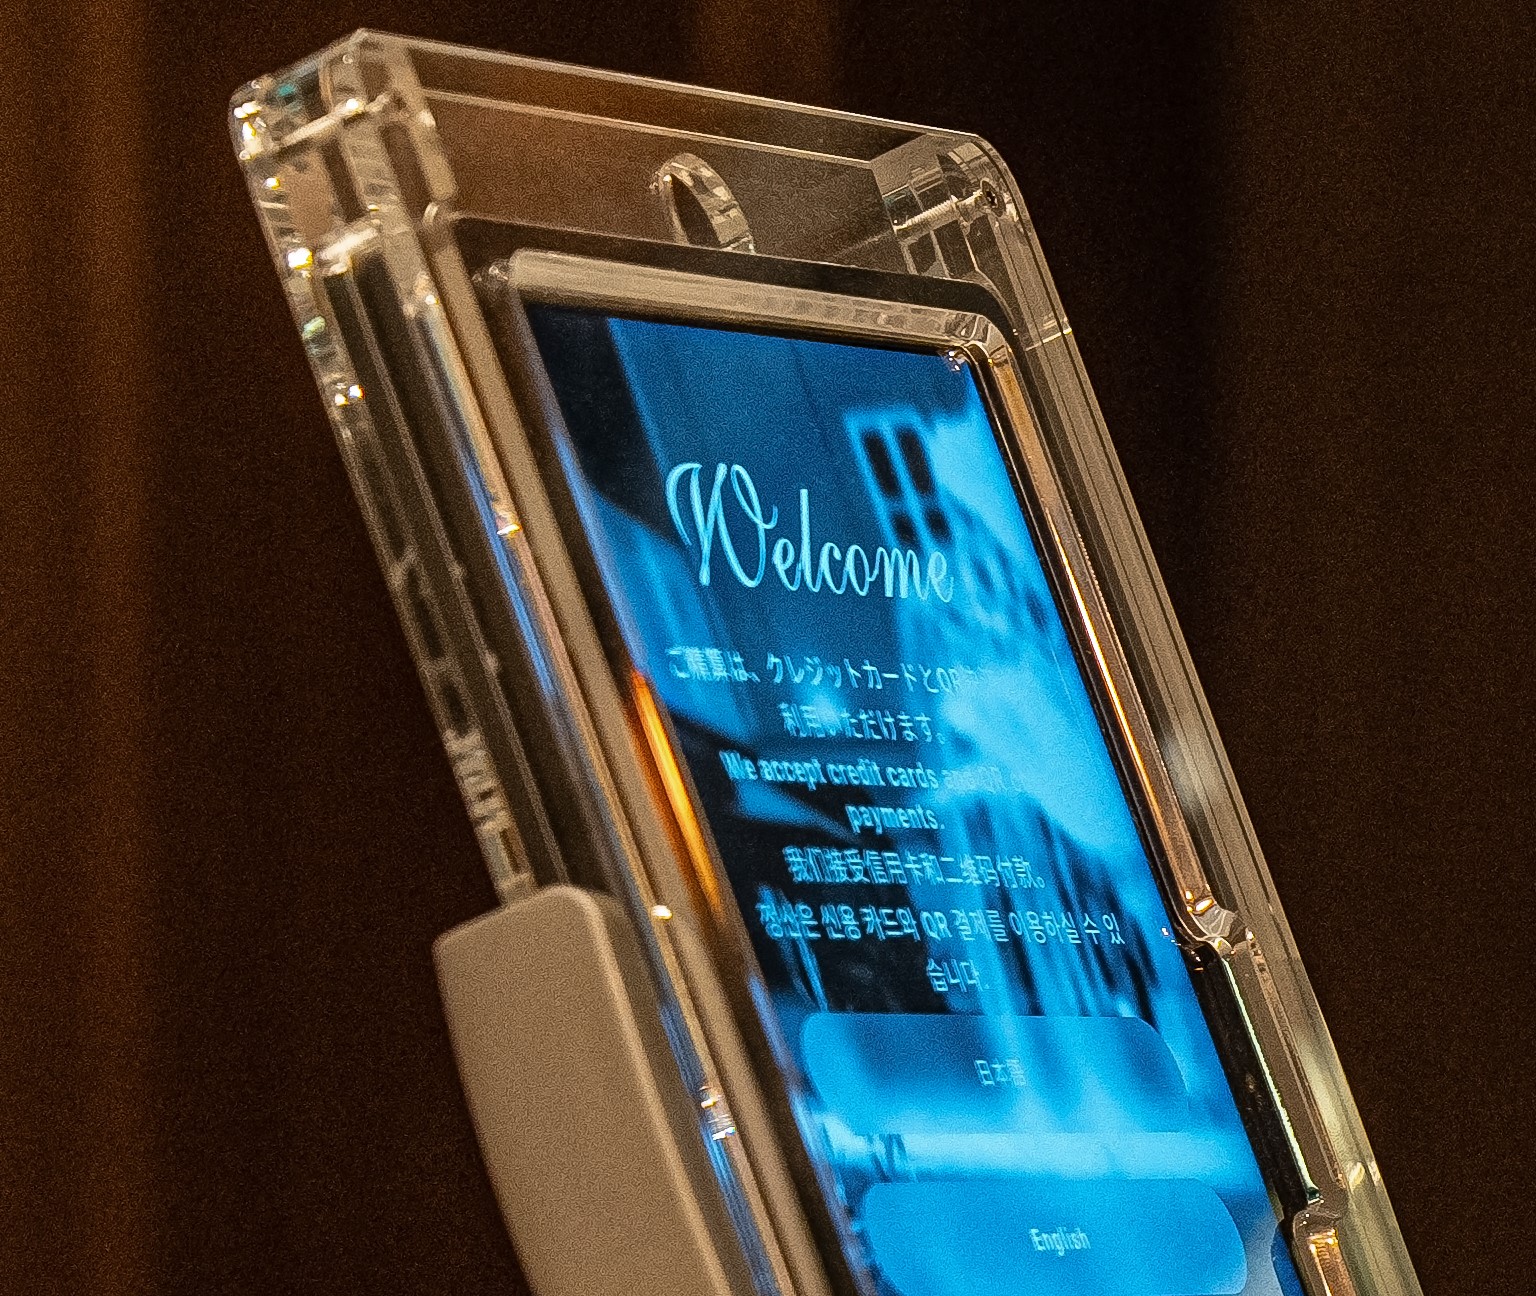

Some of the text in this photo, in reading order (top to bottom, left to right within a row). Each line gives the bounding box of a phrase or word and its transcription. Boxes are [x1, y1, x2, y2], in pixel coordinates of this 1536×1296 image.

[666, 462, 954, 603] Welcome
[719, 750, 759, 781] We
[757, 757, 828, 791] accept
[826, 757, 886, 787] credit
[885, 761, 939, 789] cards
[845, 804, 945, 835] payments.
[820, 904, 861, 942] 신용
[859, 904, 921, 943] 카드와
[920, 911, 953, 942] QR
[1008, 910, 1082, 944] 이용하실
[1082, 912, 1101, 945] 수
[1102, 912, 1126, 945] 있
[926, 957, 990, 993] 습니다.
[974, 1058, 1027, 1087] 日本語
[1029, 1226, 1092, 1257] English
